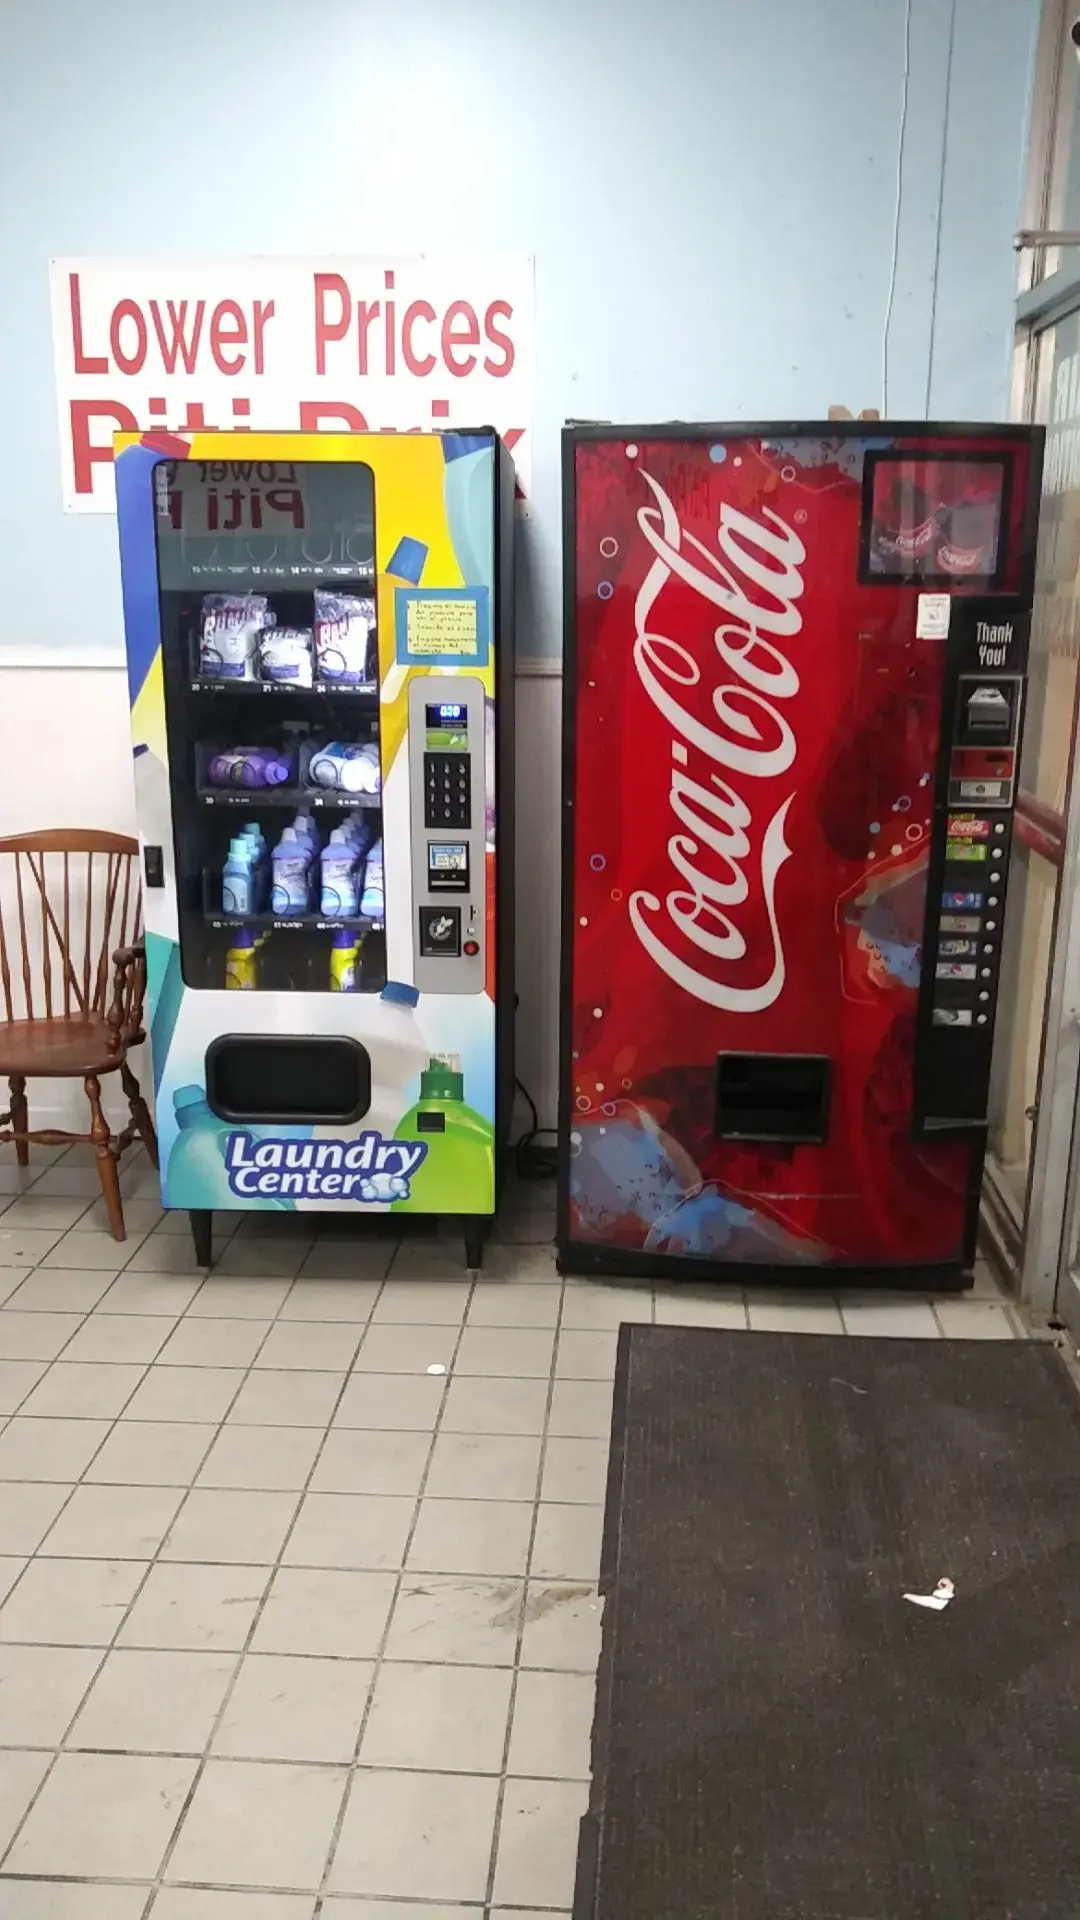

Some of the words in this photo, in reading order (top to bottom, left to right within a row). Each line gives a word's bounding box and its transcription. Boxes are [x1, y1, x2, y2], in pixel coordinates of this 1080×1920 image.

[68, 273, 275, 376] Lower
[313, 270, 515, 378] Prices
[976, 621, 1014, 644] Thank
[978, 645, 1006, 667] You!
[628, 467, 807, 1013] Coca-Cola
[231, 1136, 422, 1176] Laundry
[234, 1167, 361, 1195] Center
